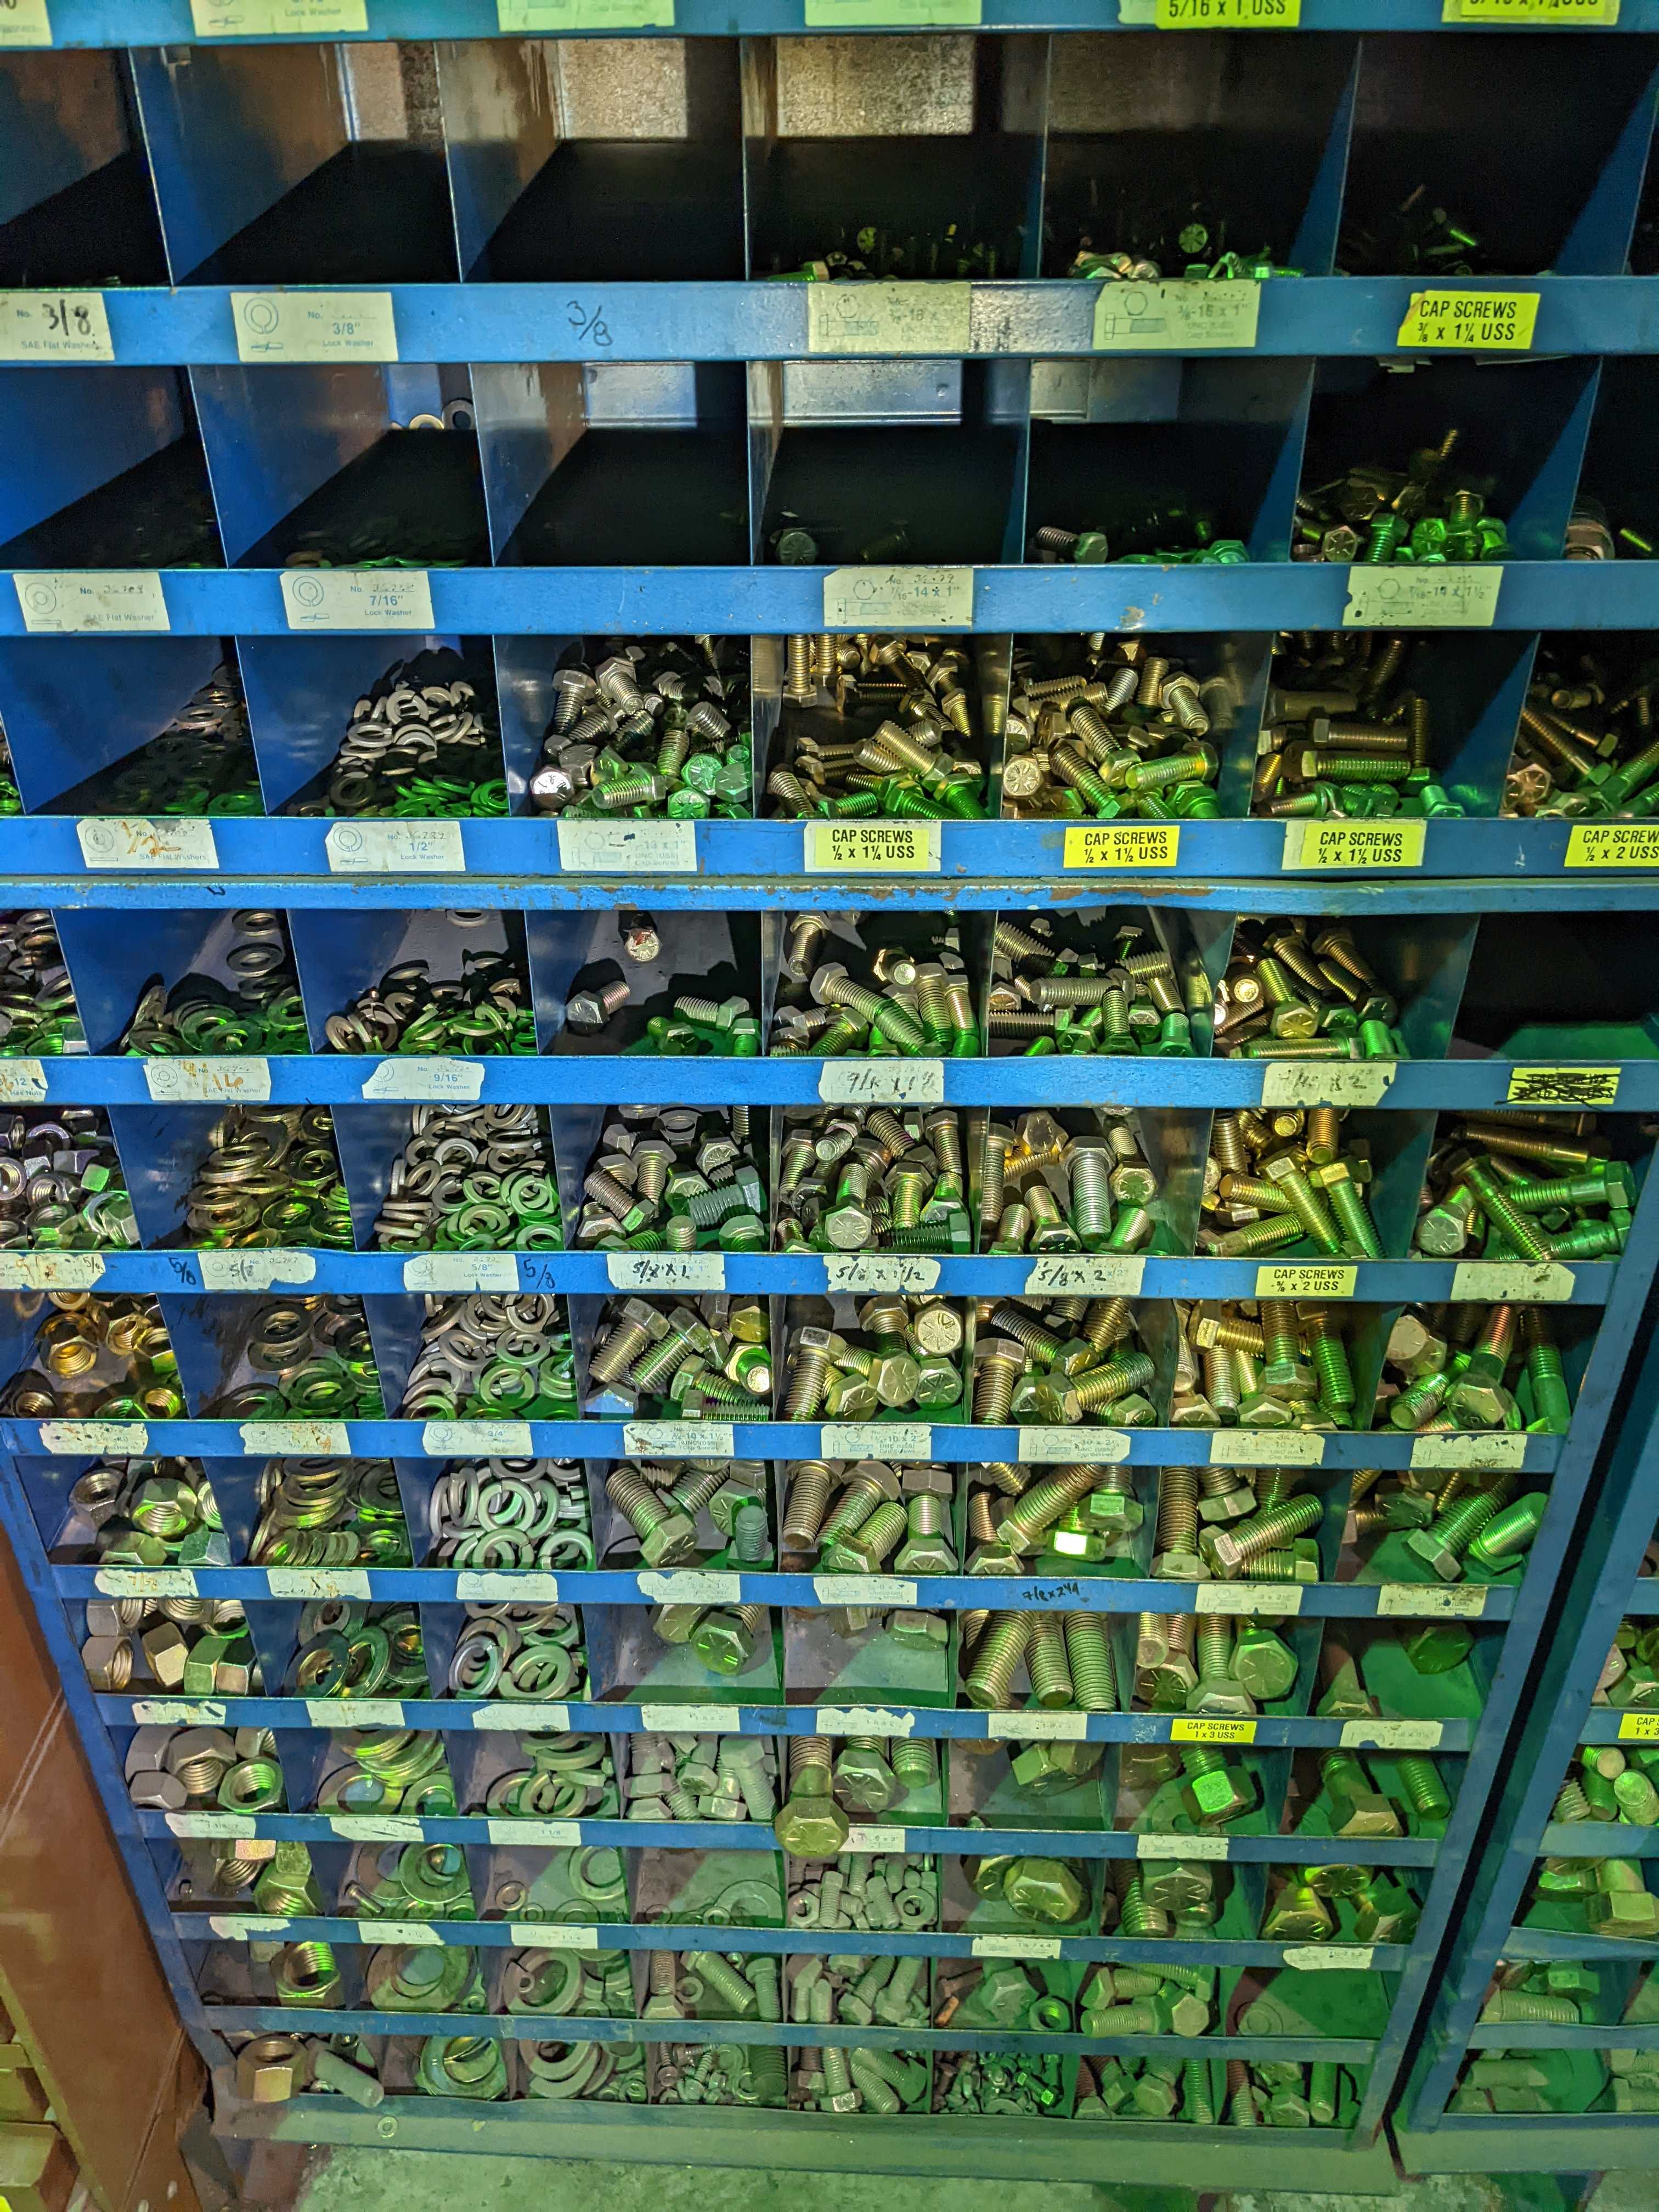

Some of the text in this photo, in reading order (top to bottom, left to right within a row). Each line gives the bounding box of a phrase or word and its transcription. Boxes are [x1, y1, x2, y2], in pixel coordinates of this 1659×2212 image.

[1217, 1, 1227, 16] x
[1252, 0, 1286, 15] USS
[1419, 301, 1517, 318] CAP SCREWS
[567, 301, 613, 347] 3/8
[1436, 327, 1446, 340] x
[1481, 323, 1515, 340] USS
[369, 595, 403, 606] 7/16"
[832, 829, 913, 844] CAP SCREWS
[1085, 831, 1167, 845] CAP SCREWS
[1320, 832, 1403, 847] CAP SCREWS
[1583, 830, 1610, 843] CAP
[409, 843, 433, 851] 1/2"
[848, 848, 856, 859] x
[886, 845, 915, 859] USS
[1101, 851, 1108, 861] x
[1138, 846, 1168, 860] USS
[1601, 849, 1610, 859] x
[1616, 846, 1626, 859] 2
[1333, 851, 1342, 862] x
[1372, 848, 1402, 863] USS
[433, 1074, 463, 1082] 9/16"
[168, 1256, 197, 1286] 5/8
[523, 1258, 556, 1290] 5/8
[1094, 1269, 1107, 1282] 2
[1273, 1269, 1345, 1279] CAP SCREWS
[1290, 1283, 1299, 1291] x
[1302, 1281, 1311, 1291] 2
[1313, 1281, 1339, 1291] USS
[1207, 1723, 1245, 1731] SCREWS
[1637, 1717, 1655, 1725] CAP
[1635, 1726, 1641, 1735] 1
